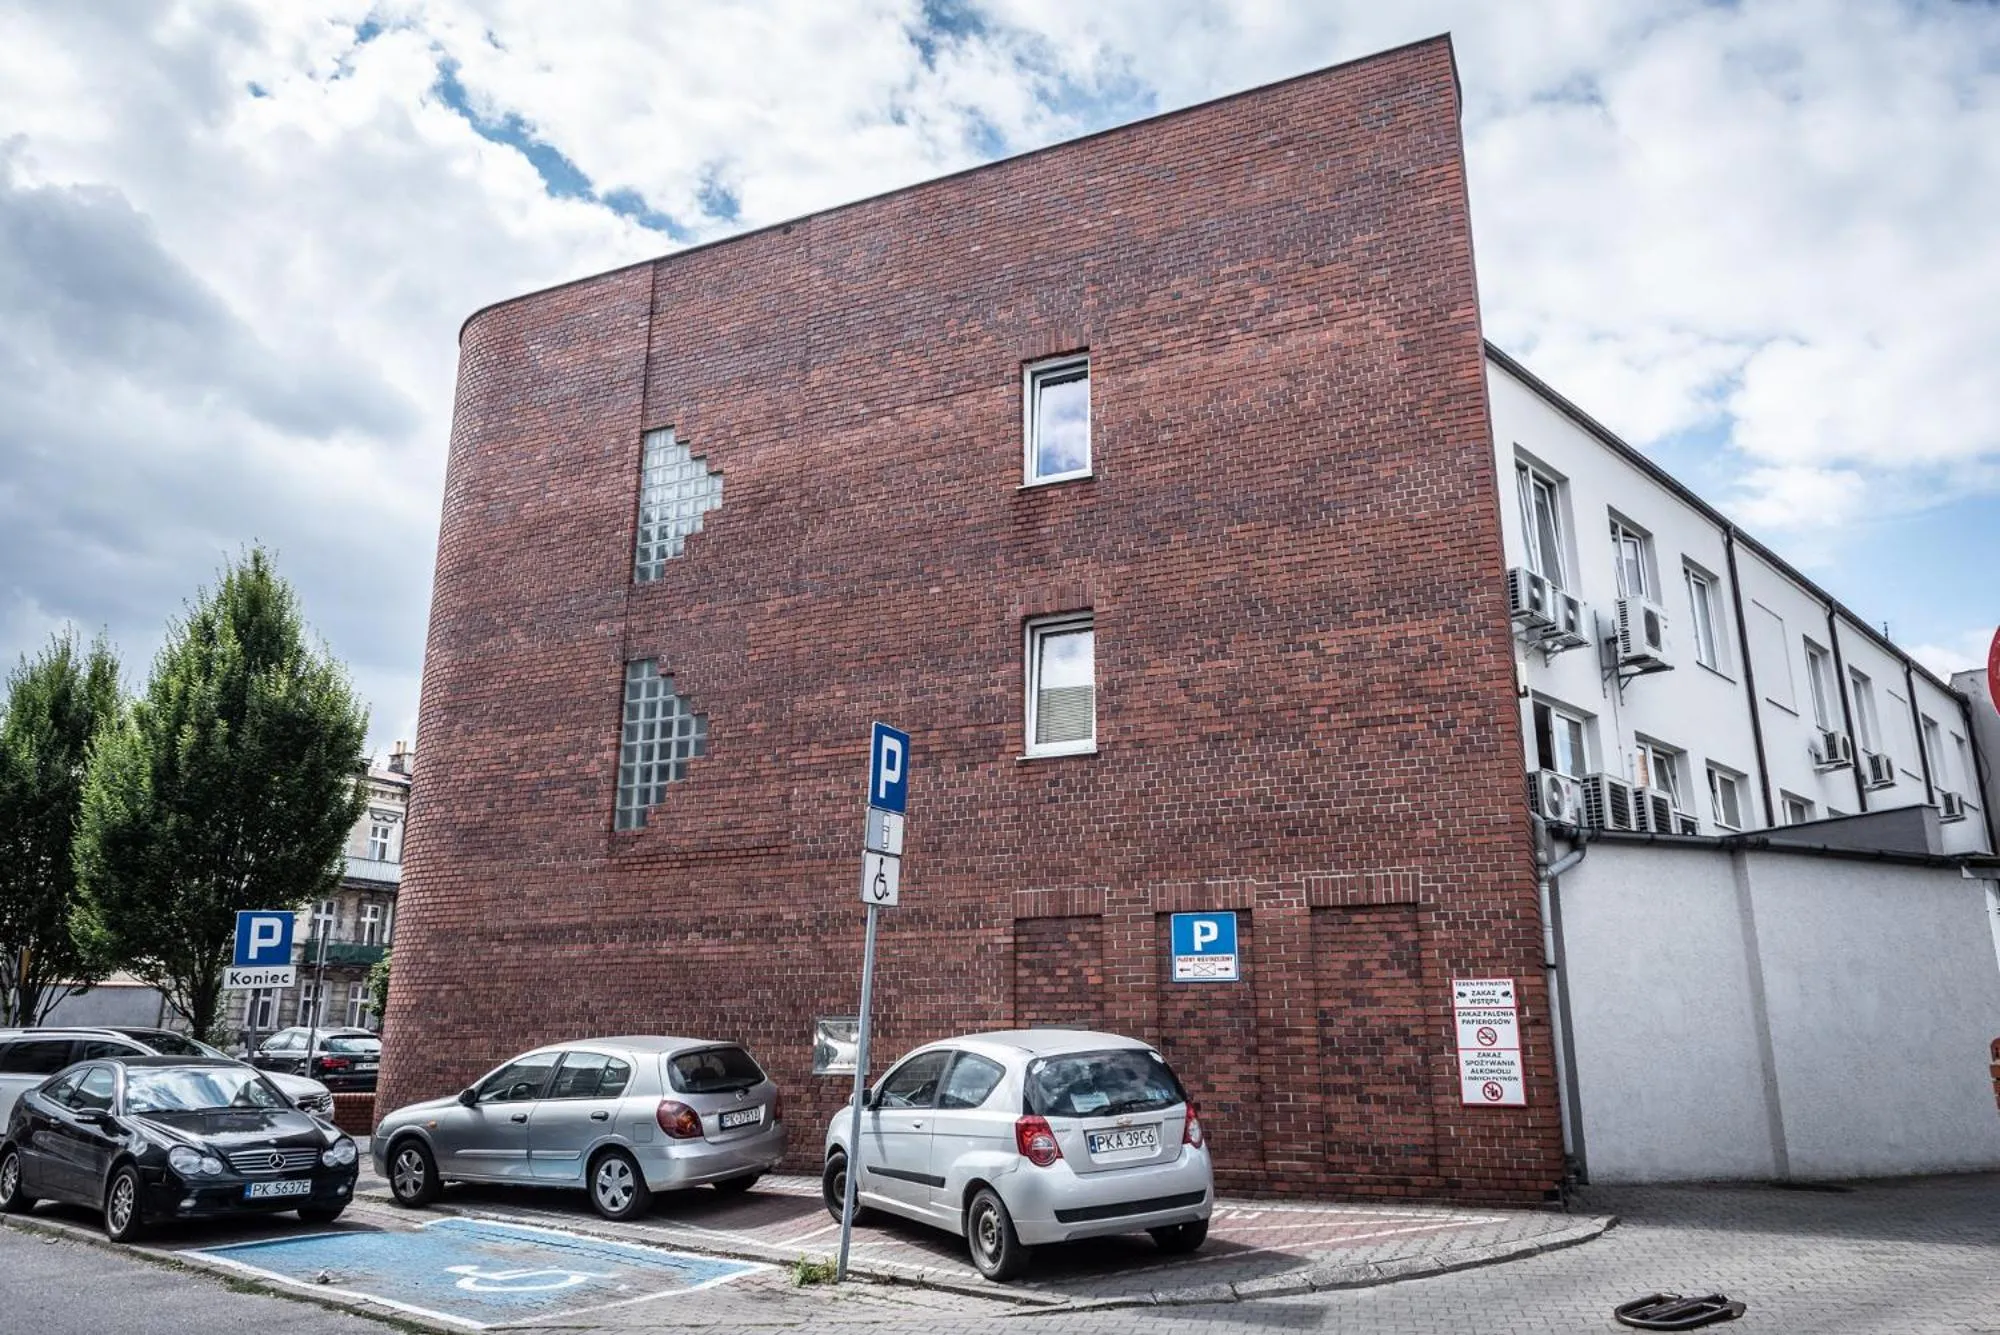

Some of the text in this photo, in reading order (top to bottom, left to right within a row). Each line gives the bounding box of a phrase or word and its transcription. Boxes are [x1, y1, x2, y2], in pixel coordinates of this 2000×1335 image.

[879, 734, 902, 798] P
[248, 917, 283, 959] P
[1193, 920, 1218, 951] P
[230, 970, 289, 985] Koniec
[1096, 1130, 1154, 1150] PKA 39C6
[253, 1181, 309, 1196] PK 5637E
